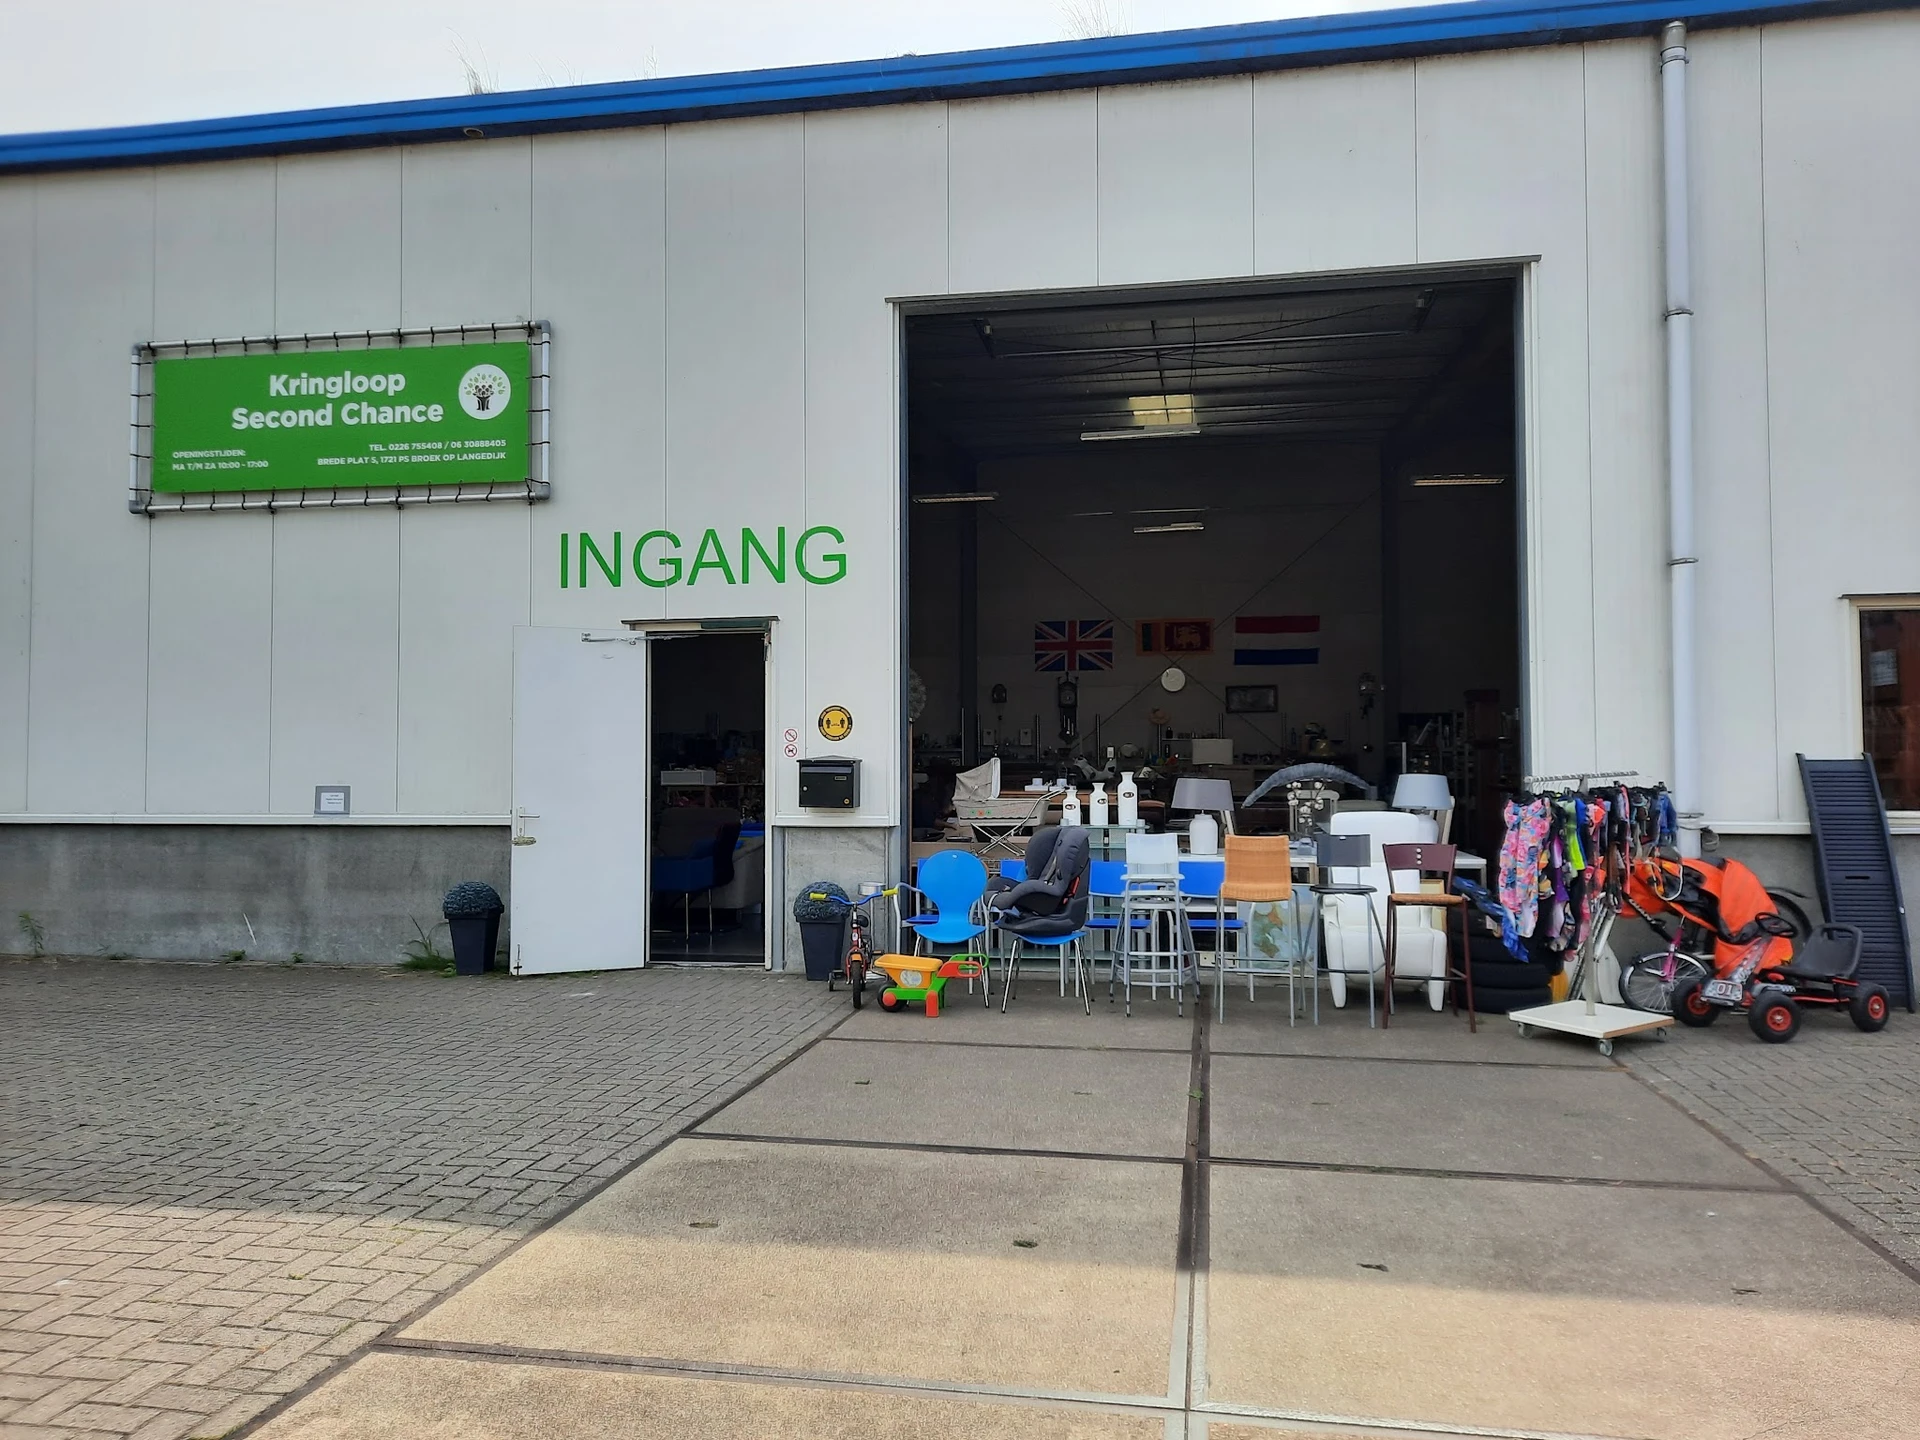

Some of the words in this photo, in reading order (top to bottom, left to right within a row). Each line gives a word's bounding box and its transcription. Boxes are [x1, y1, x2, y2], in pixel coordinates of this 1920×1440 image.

[269, 371, 406, 399] Kringloop
[231, 403, 333, 430] Second
[340, 402, 444, 426] Chance
[389, 442, 409, 451] 0226
[412, 441, 442, 450] 755408
[451, 440, 462, 449] 06
[187, 462, 203, 471] T/M
[204, 462, 217, 470] ZA
[218, 461, 240, 469] 10:00
[247, 460, 269, 468] 17:00
[317, 457, 346, 466] BREDE
[380, 454, 397, 463] 1721
[399, 454, 410, 463] PS
[412, 453, 441, 462] BROEK
[443, 452, 455, 461] OP
[457, 452, 506, 460] LANGEDIJK
[560, 525, 848, 589] INGANG
